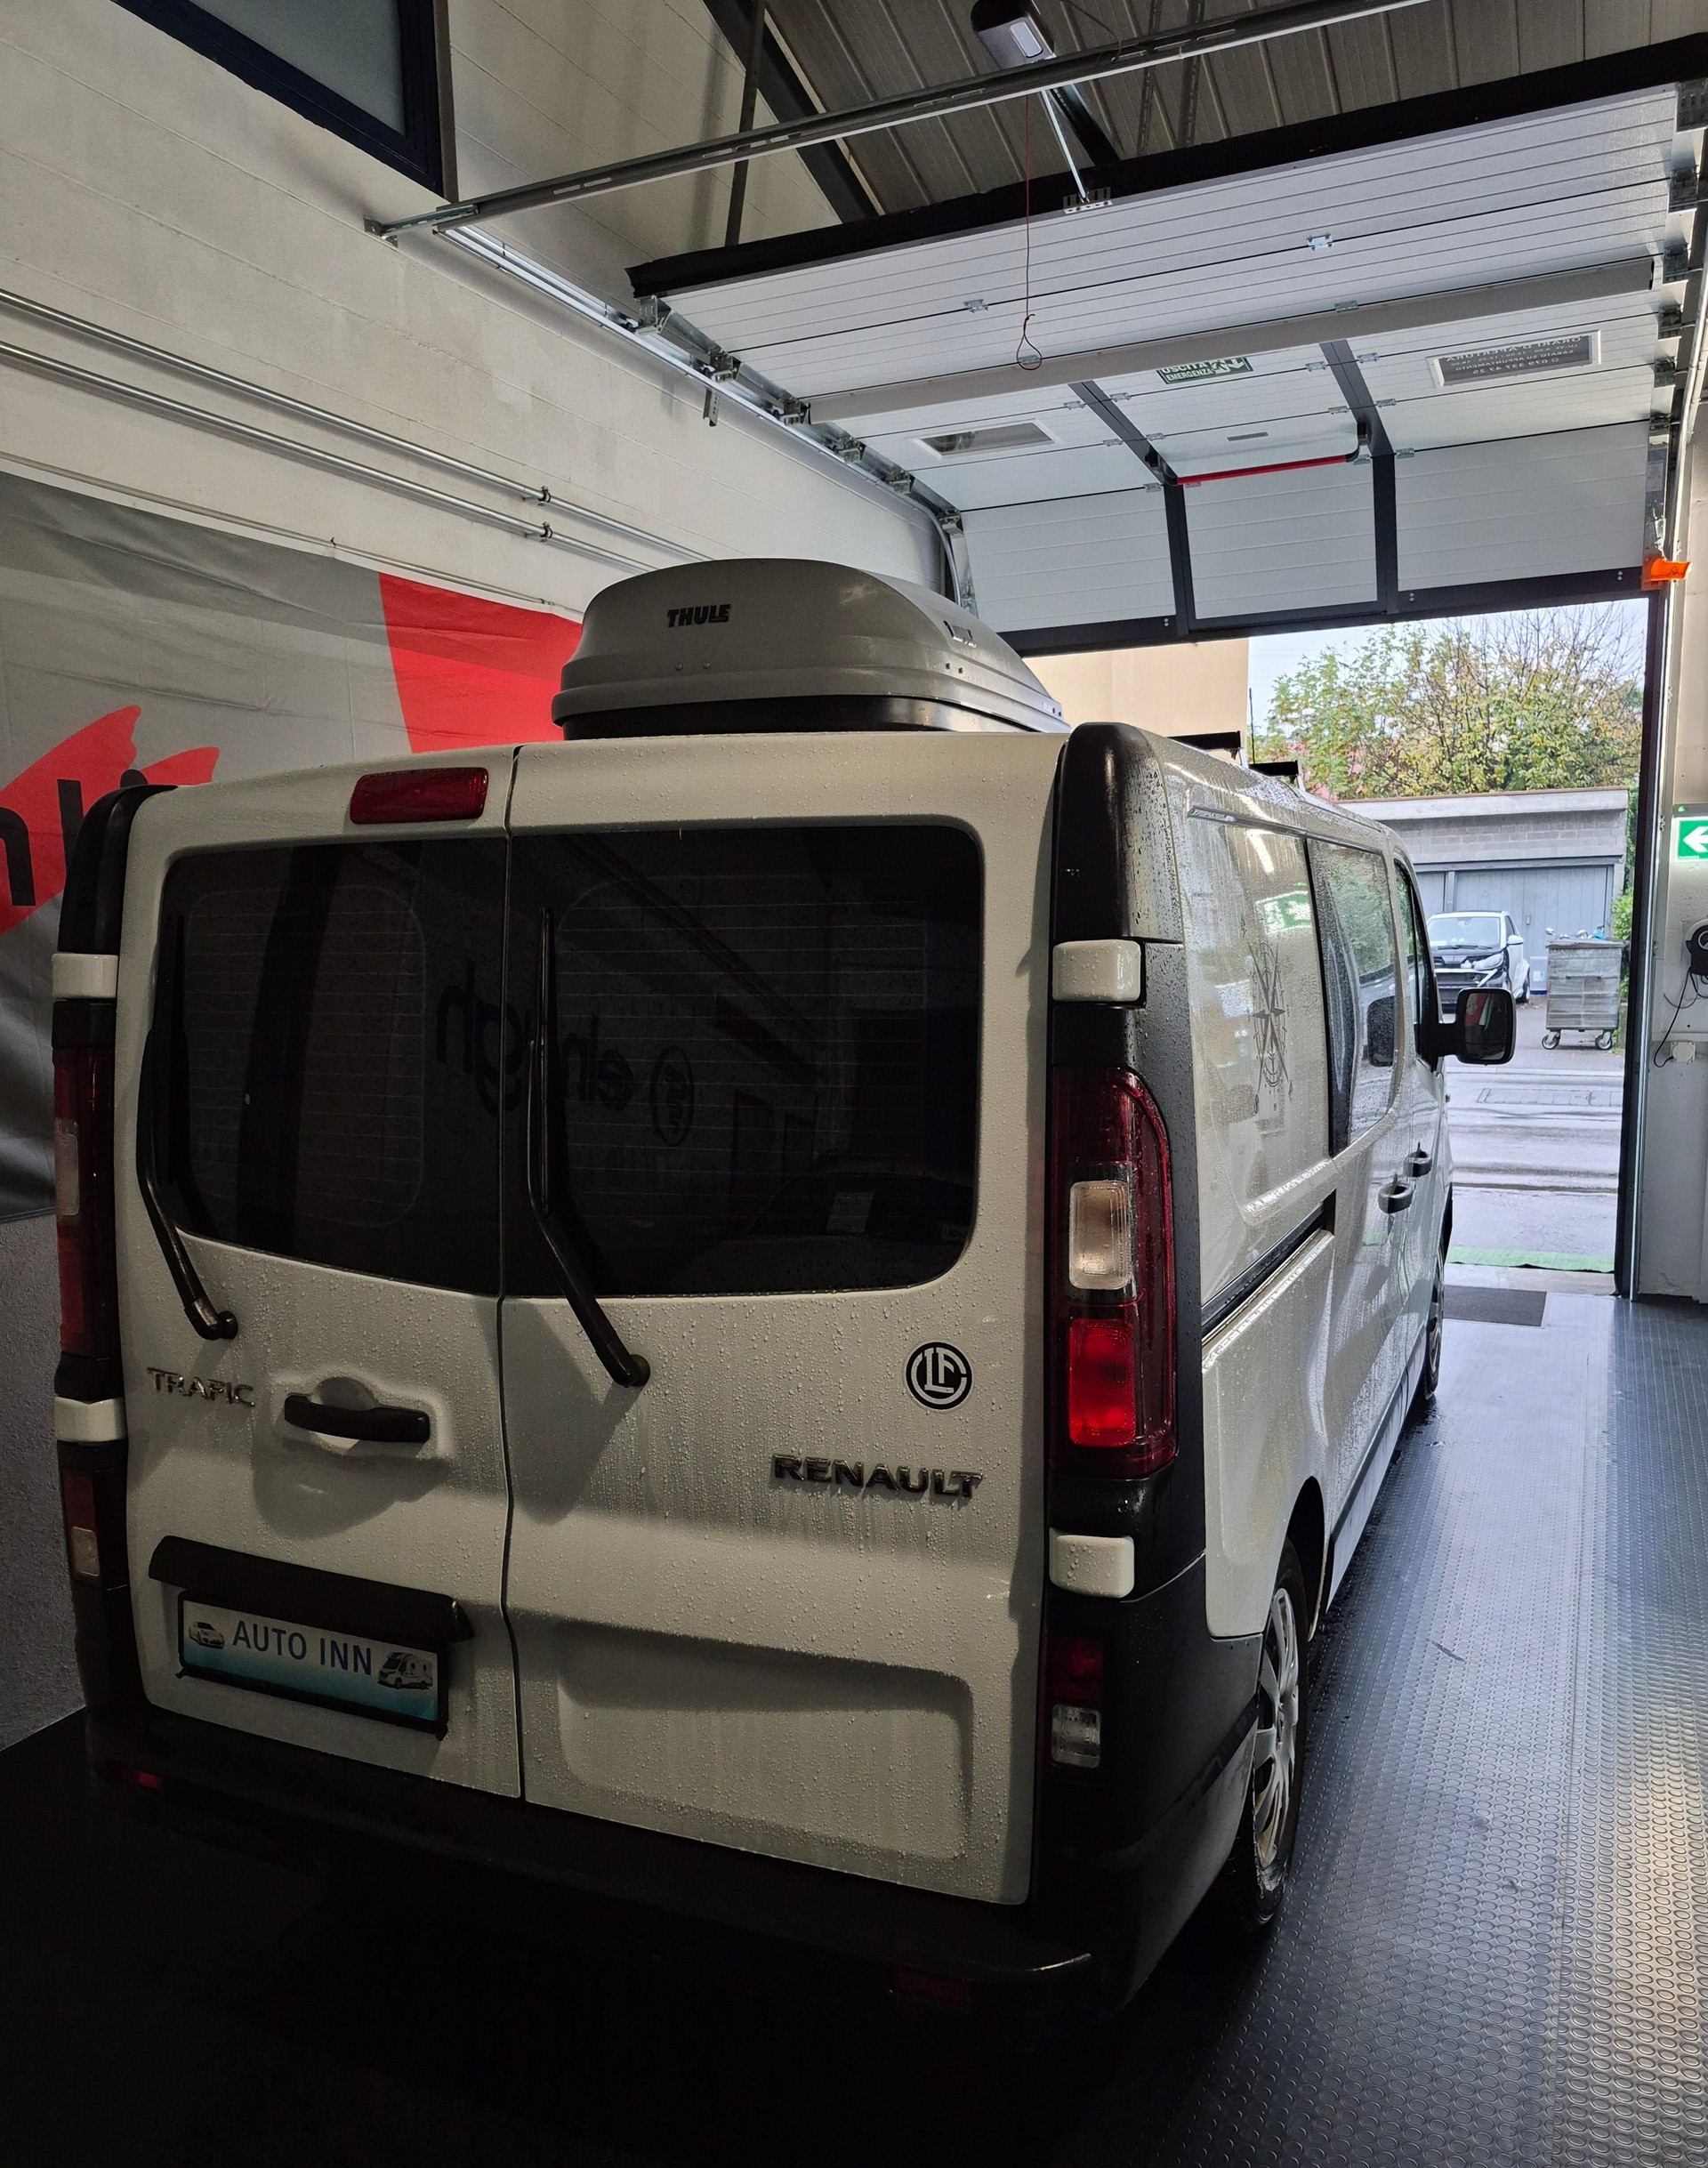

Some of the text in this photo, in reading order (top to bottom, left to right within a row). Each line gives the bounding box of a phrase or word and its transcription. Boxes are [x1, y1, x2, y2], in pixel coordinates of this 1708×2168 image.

[1161, 362, 1208, 374] USCITA
[1166, 368, 1214, 381] EMERGENZA
[666, 603, 732, 628] THULE
[147, 1366, 256, 1407] TRAFIC
[772, 1454, 984, 1498] RENAULT
[232, 1620, 372, 1675] AUTO INN
